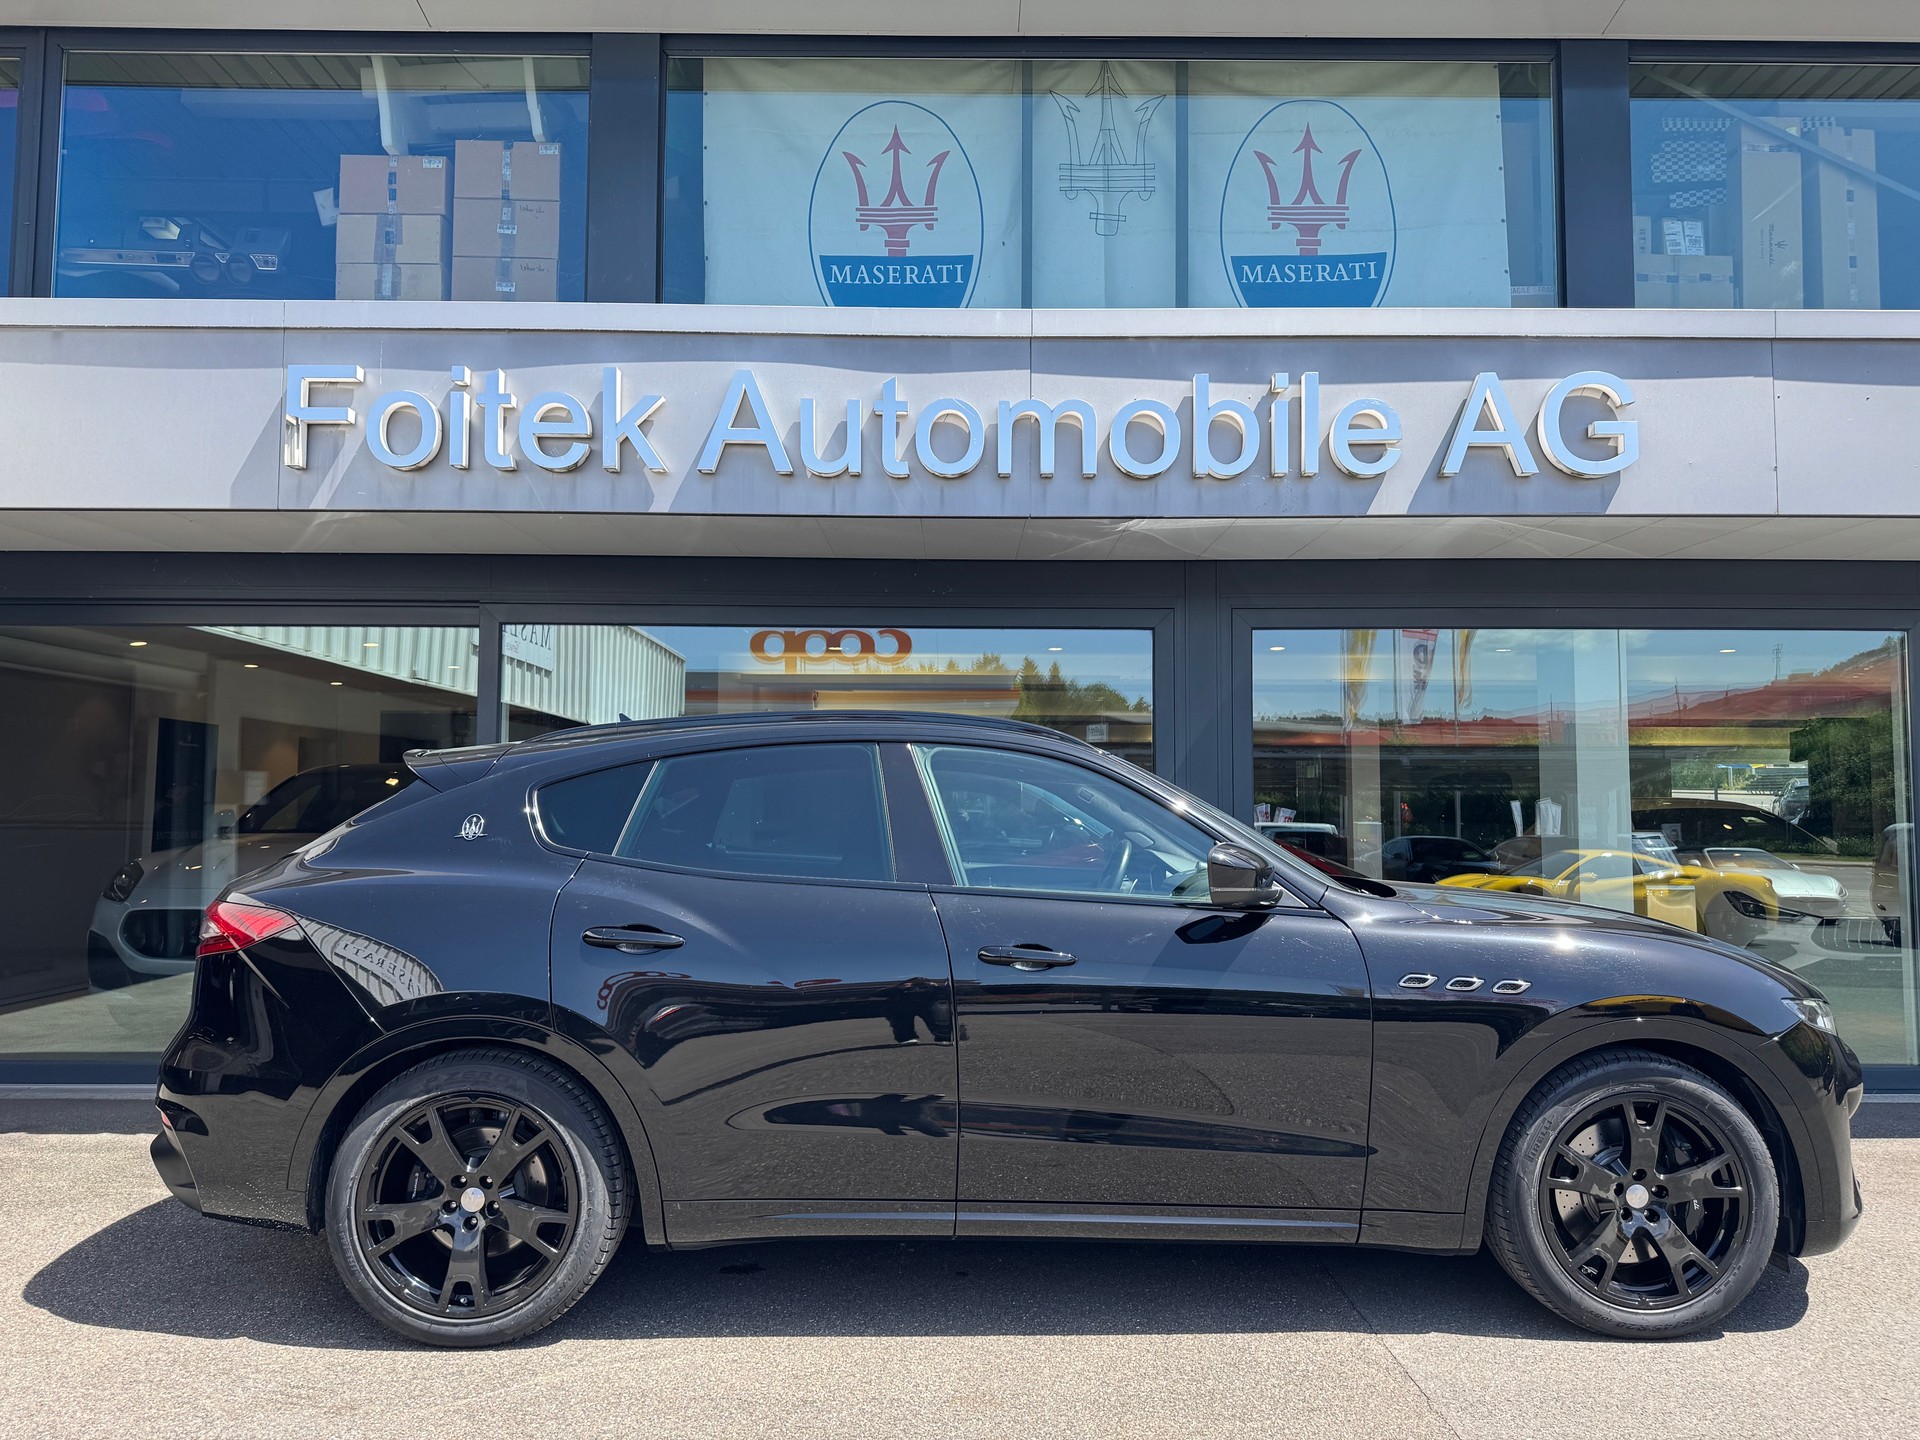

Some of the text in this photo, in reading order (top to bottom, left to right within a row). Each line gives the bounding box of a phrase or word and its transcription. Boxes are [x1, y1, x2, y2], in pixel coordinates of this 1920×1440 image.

[829, 264, 964, 285] MASERATI
[1241, 261, 1378, 284] MASERATI
[284, 364, 1639, 479] Foitek Automobile AG
